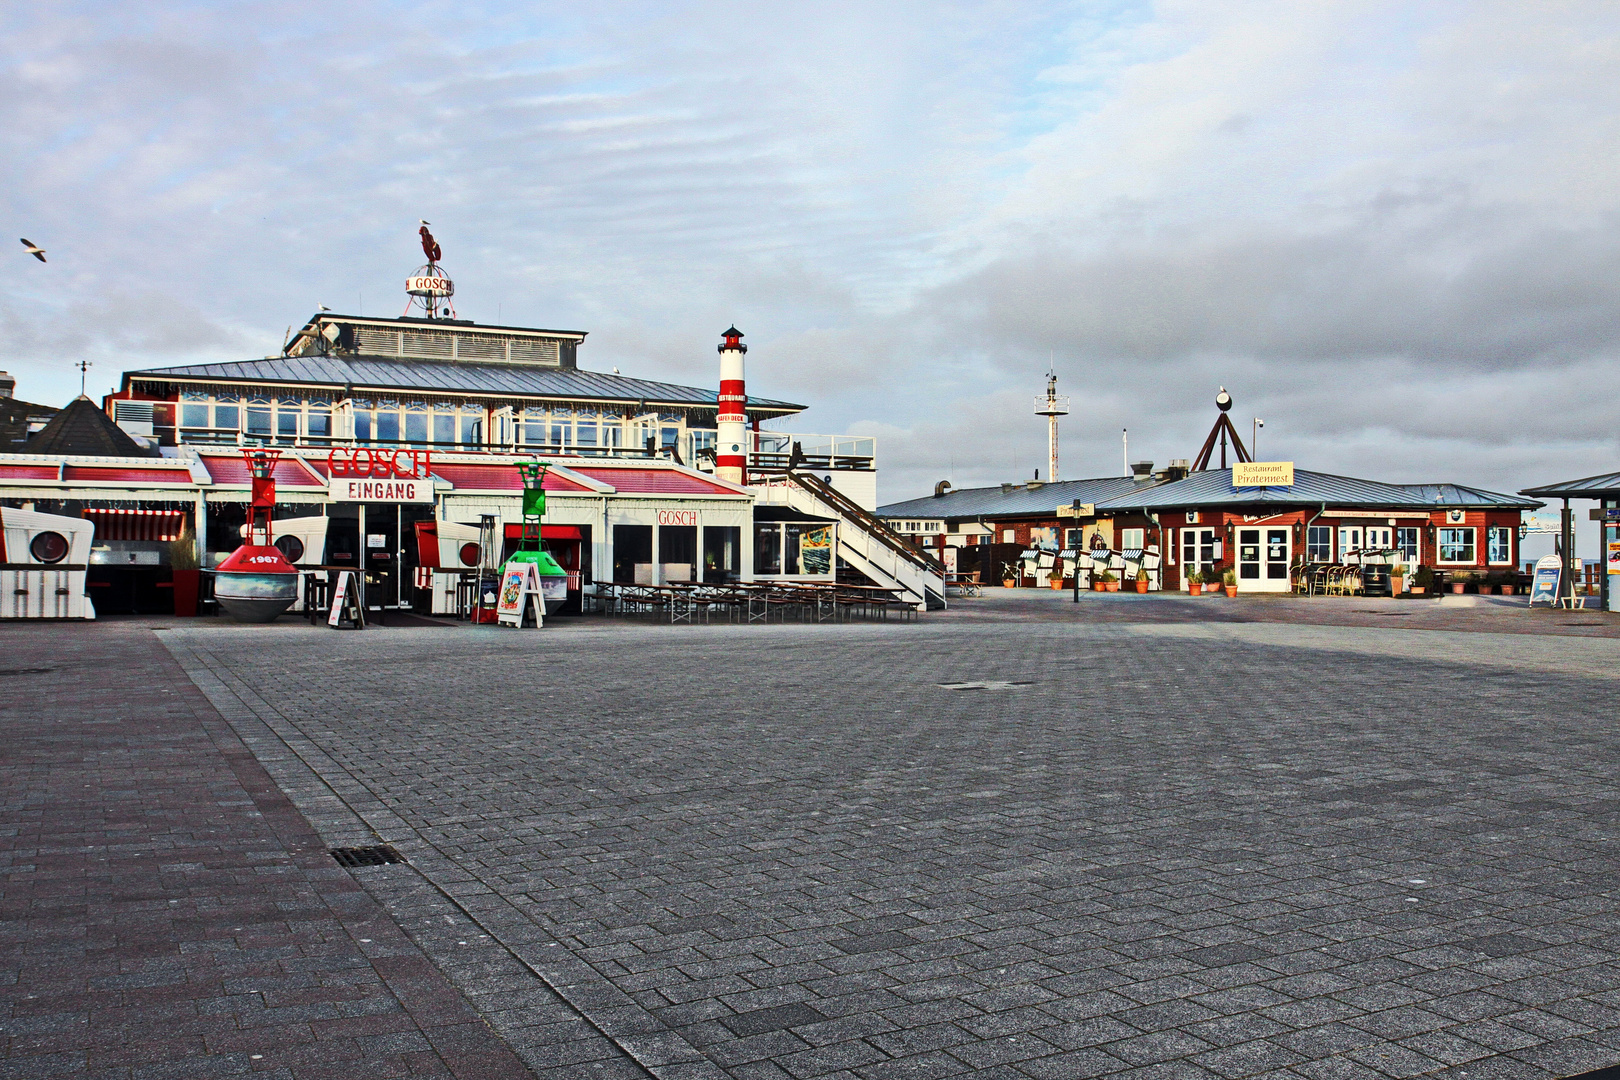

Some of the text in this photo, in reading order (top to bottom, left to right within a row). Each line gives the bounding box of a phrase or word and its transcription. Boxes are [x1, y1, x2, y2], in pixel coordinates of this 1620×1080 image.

[415, 277, 452, 291] GOSCH
[327, 447, 433, 477] GOSCH
[1237, 474, 1289, 484] Piratennest
[348, 482, 415, 500] EINGANG
[658, 510, 697, 526] GOSCH
[249, 555, 279, 564] 1967
